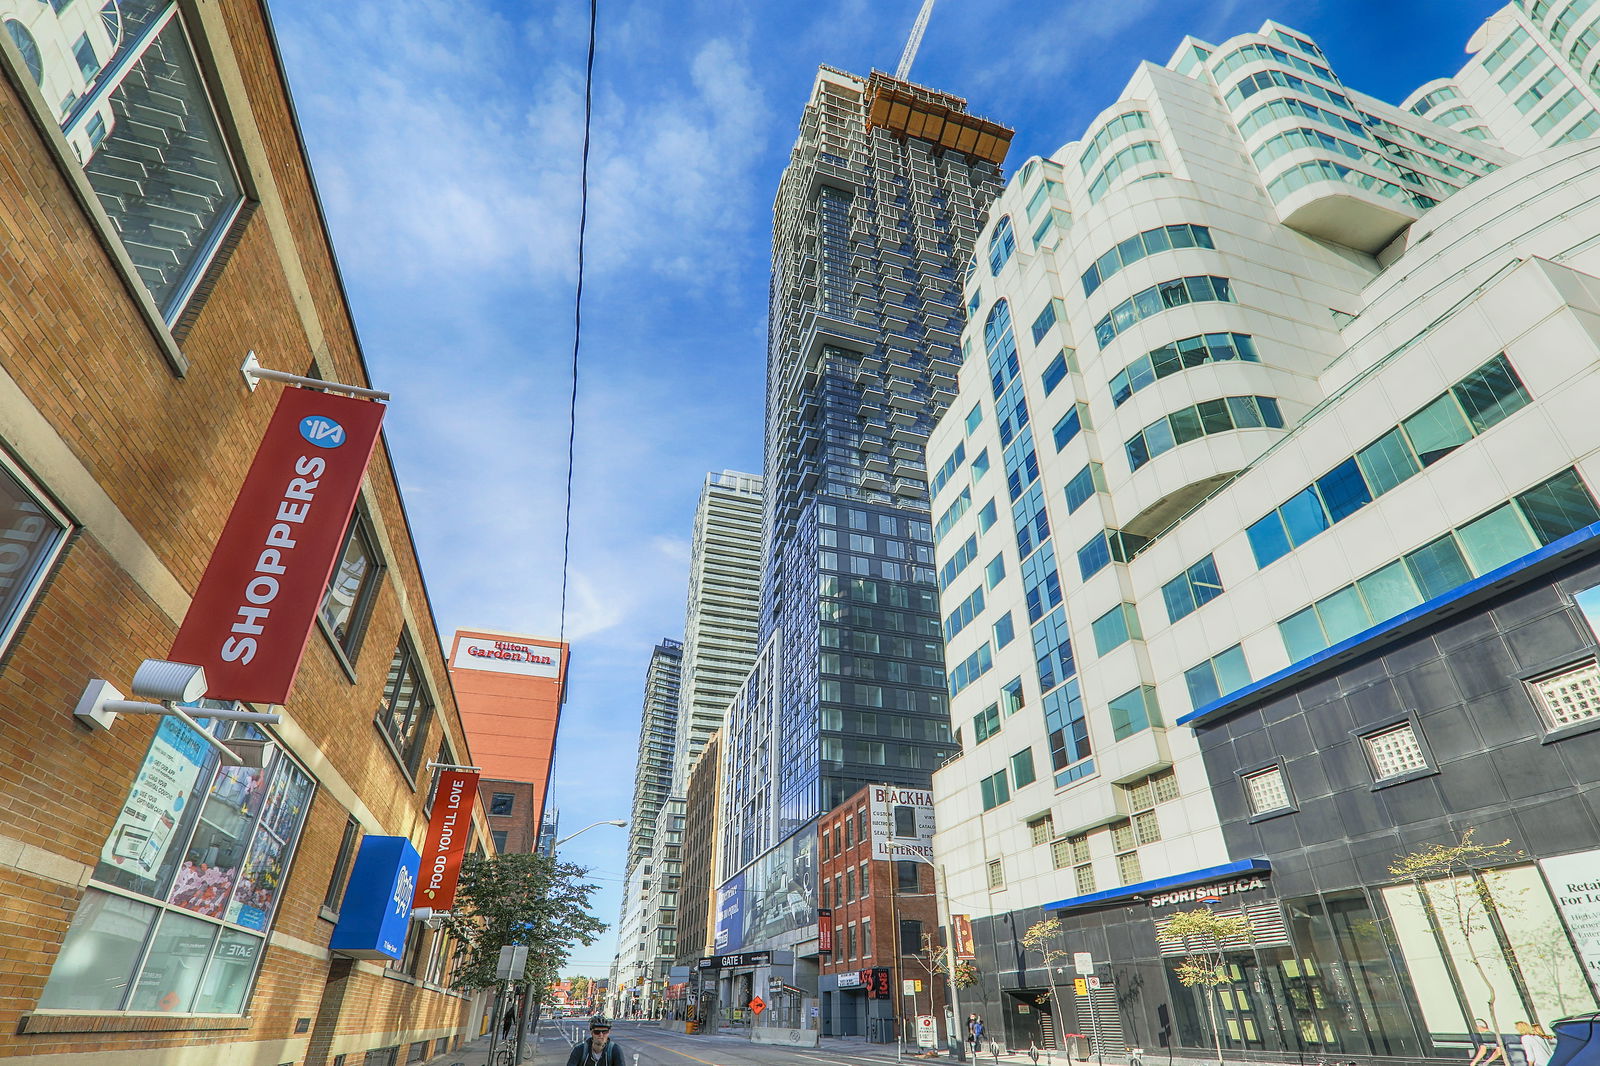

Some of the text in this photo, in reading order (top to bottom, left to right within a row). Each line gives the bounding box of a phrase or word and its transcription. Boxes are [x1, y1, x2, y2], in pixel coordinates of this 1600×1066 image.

[221, 455, 326, 666] SHOPPERS
[494, 641, 529, 652] Hilton
[467, 646, 551, 665] Garden Inn
[430, 780, 465, 889] FOOD YOU'LL LOVE
[1560, 896, 1582, 906] For
[721, 955, 739, 966] GATE
[740, 955, 743, 965] 1
